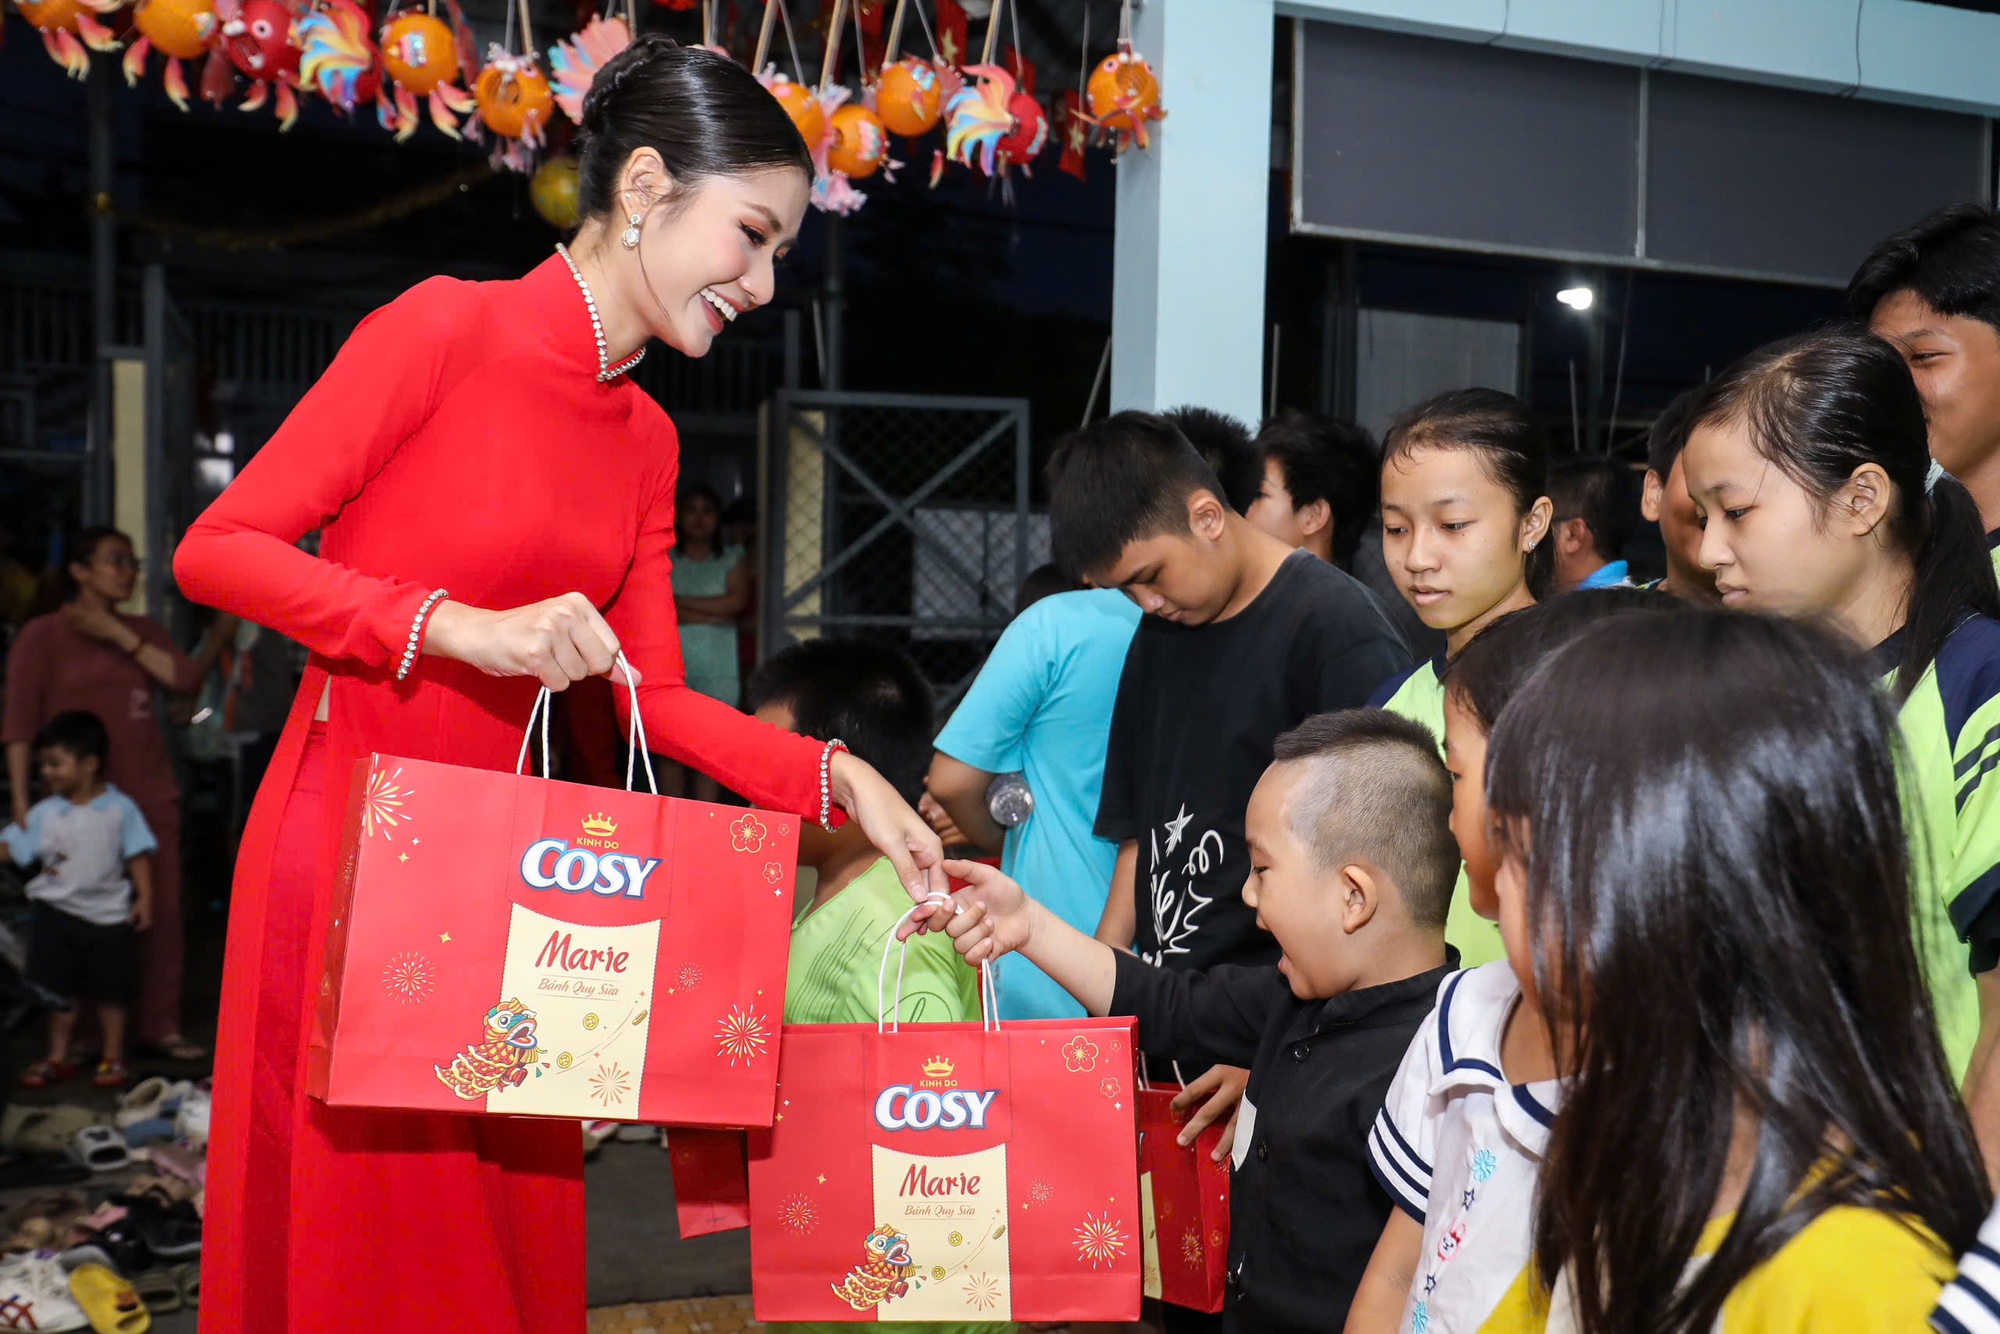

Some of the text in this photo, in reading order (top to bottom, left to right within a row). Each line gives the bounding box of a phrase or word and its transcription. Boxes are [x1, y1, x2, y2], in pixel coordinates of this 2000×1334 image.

[576, 837, 619, 849] KINH DO
[520, 837, 663, 899] COSY
[535, 930, 629, 973] Marie
[538, 978, 569, 992] Bánh
[573, 981, 596, 997] Quy
[919, 1079, 958, 1087] KINH DO
[874, 1083, 1001, 1132] COSY
[899, 1163, 981, 1198] Marie
[904, 1204, 931, 1216] Bánh
[934, 1204, 955, 1219] Quy
